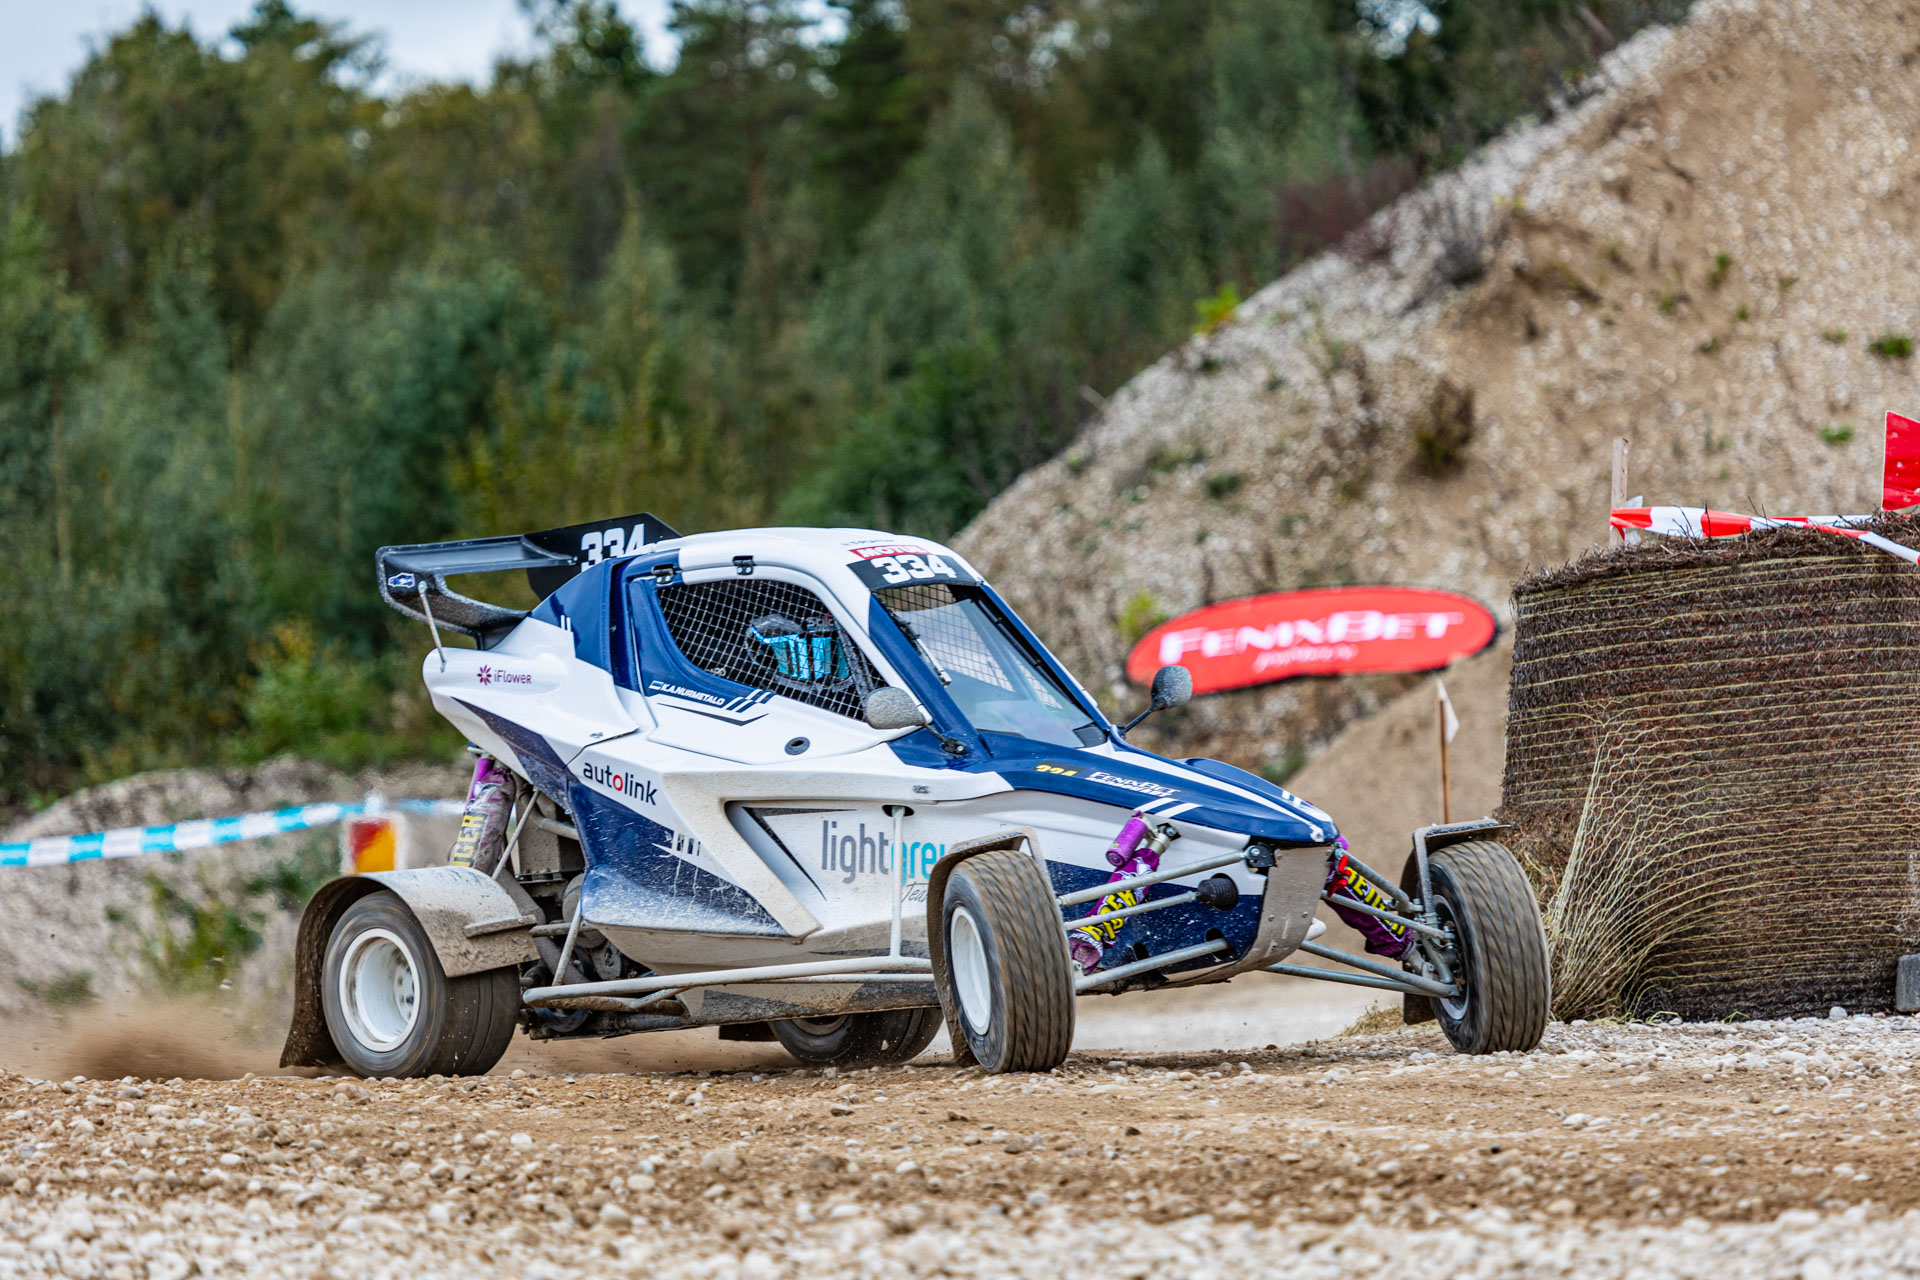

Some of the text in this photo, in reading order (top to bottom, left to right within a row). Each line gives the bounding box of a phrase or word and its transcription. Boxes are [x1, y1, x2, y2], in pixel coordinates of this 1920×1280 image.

[581, 523, 645, 573] 334
[858, 545, 929, 558] MOTUL
[870, 554, 957, 584] 334
[583, 762, 658, 806] autolink
[822, 820, 945, 888] lightgre
